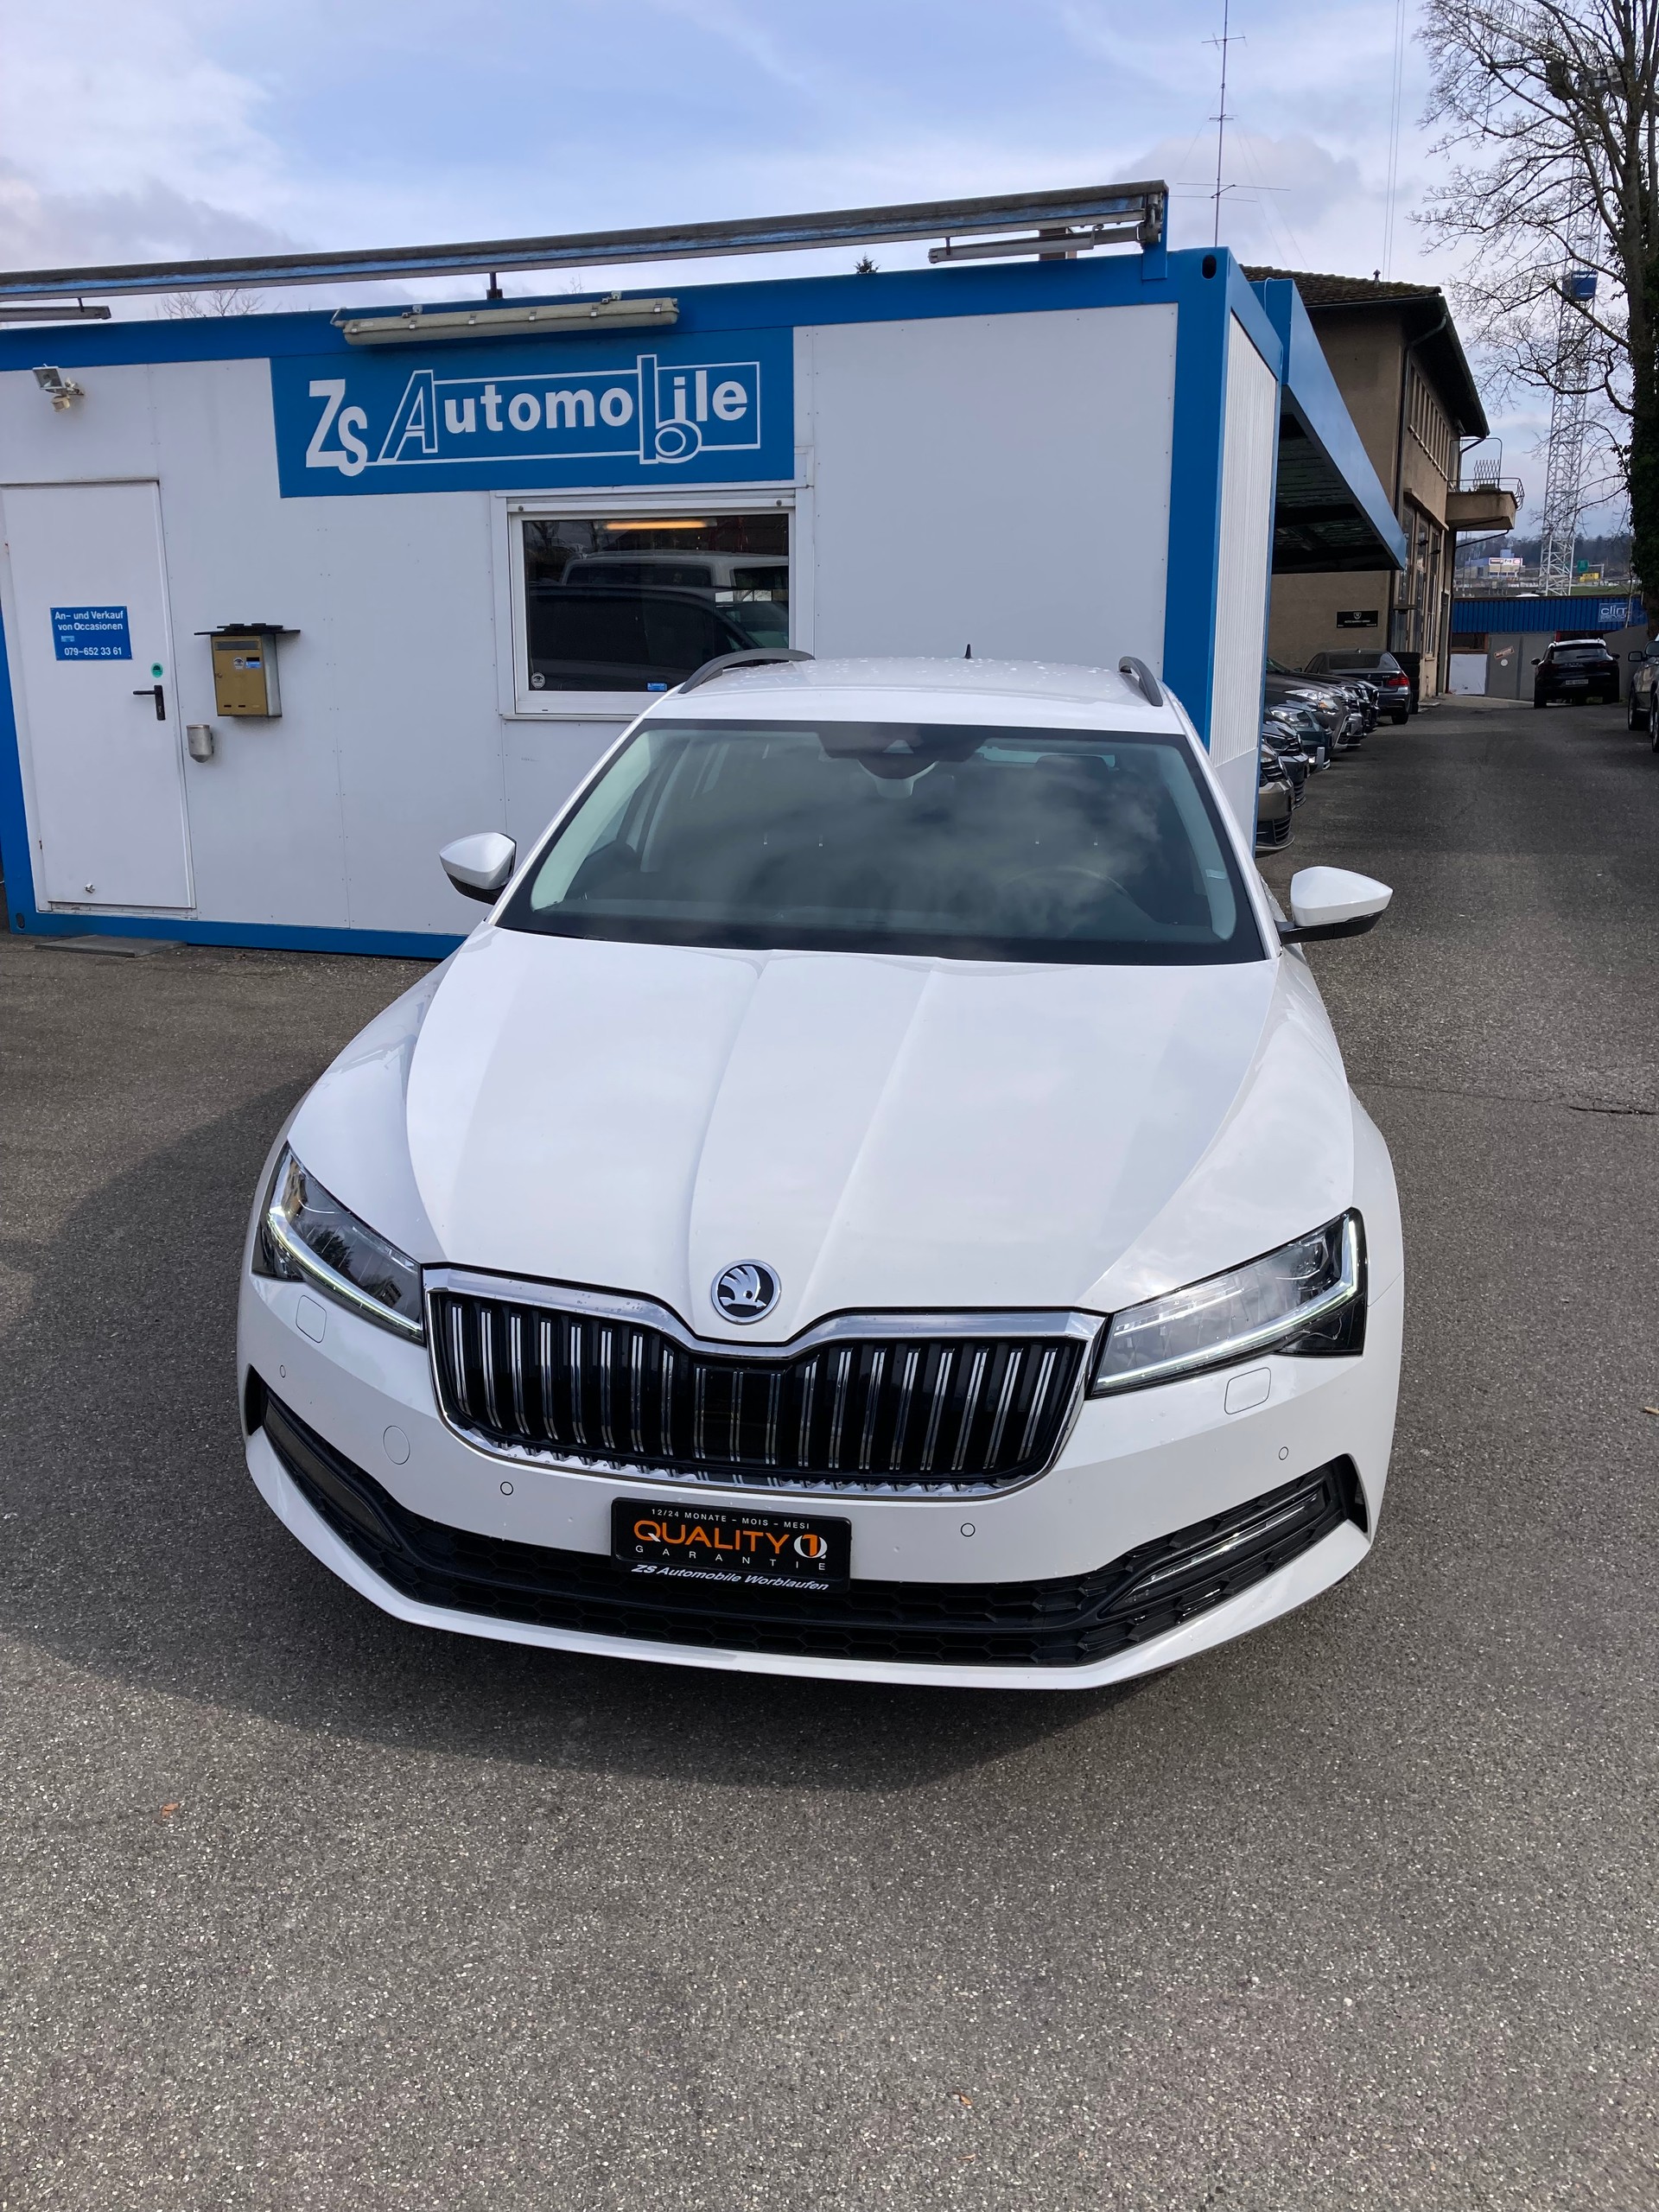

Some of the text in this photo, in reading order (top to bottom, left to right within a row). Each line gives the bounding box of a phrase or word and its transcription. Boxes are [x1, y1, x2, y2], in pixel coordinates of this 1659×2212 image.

[378, 353, 749, 465] Automobile
[54, 610, 124, 620] An- und Verkauf
[73, 621, 124, 631] Occasionen
[64, 646, 122, 656] 079-652 33 61
[652, 1508, 680, 1518] 12/24
[684, 1511, 727, 1522] MONATE
[741, 1517, 769, 1527] MOIS
[784, 1521, 810, 1529] MESI
[633, 1520, 790, 1554] QUALITY
[635, 1545, 826, 1571] GARANTIE
[631, 1564, 830, 1591] ZS Automobile Worblaufen
